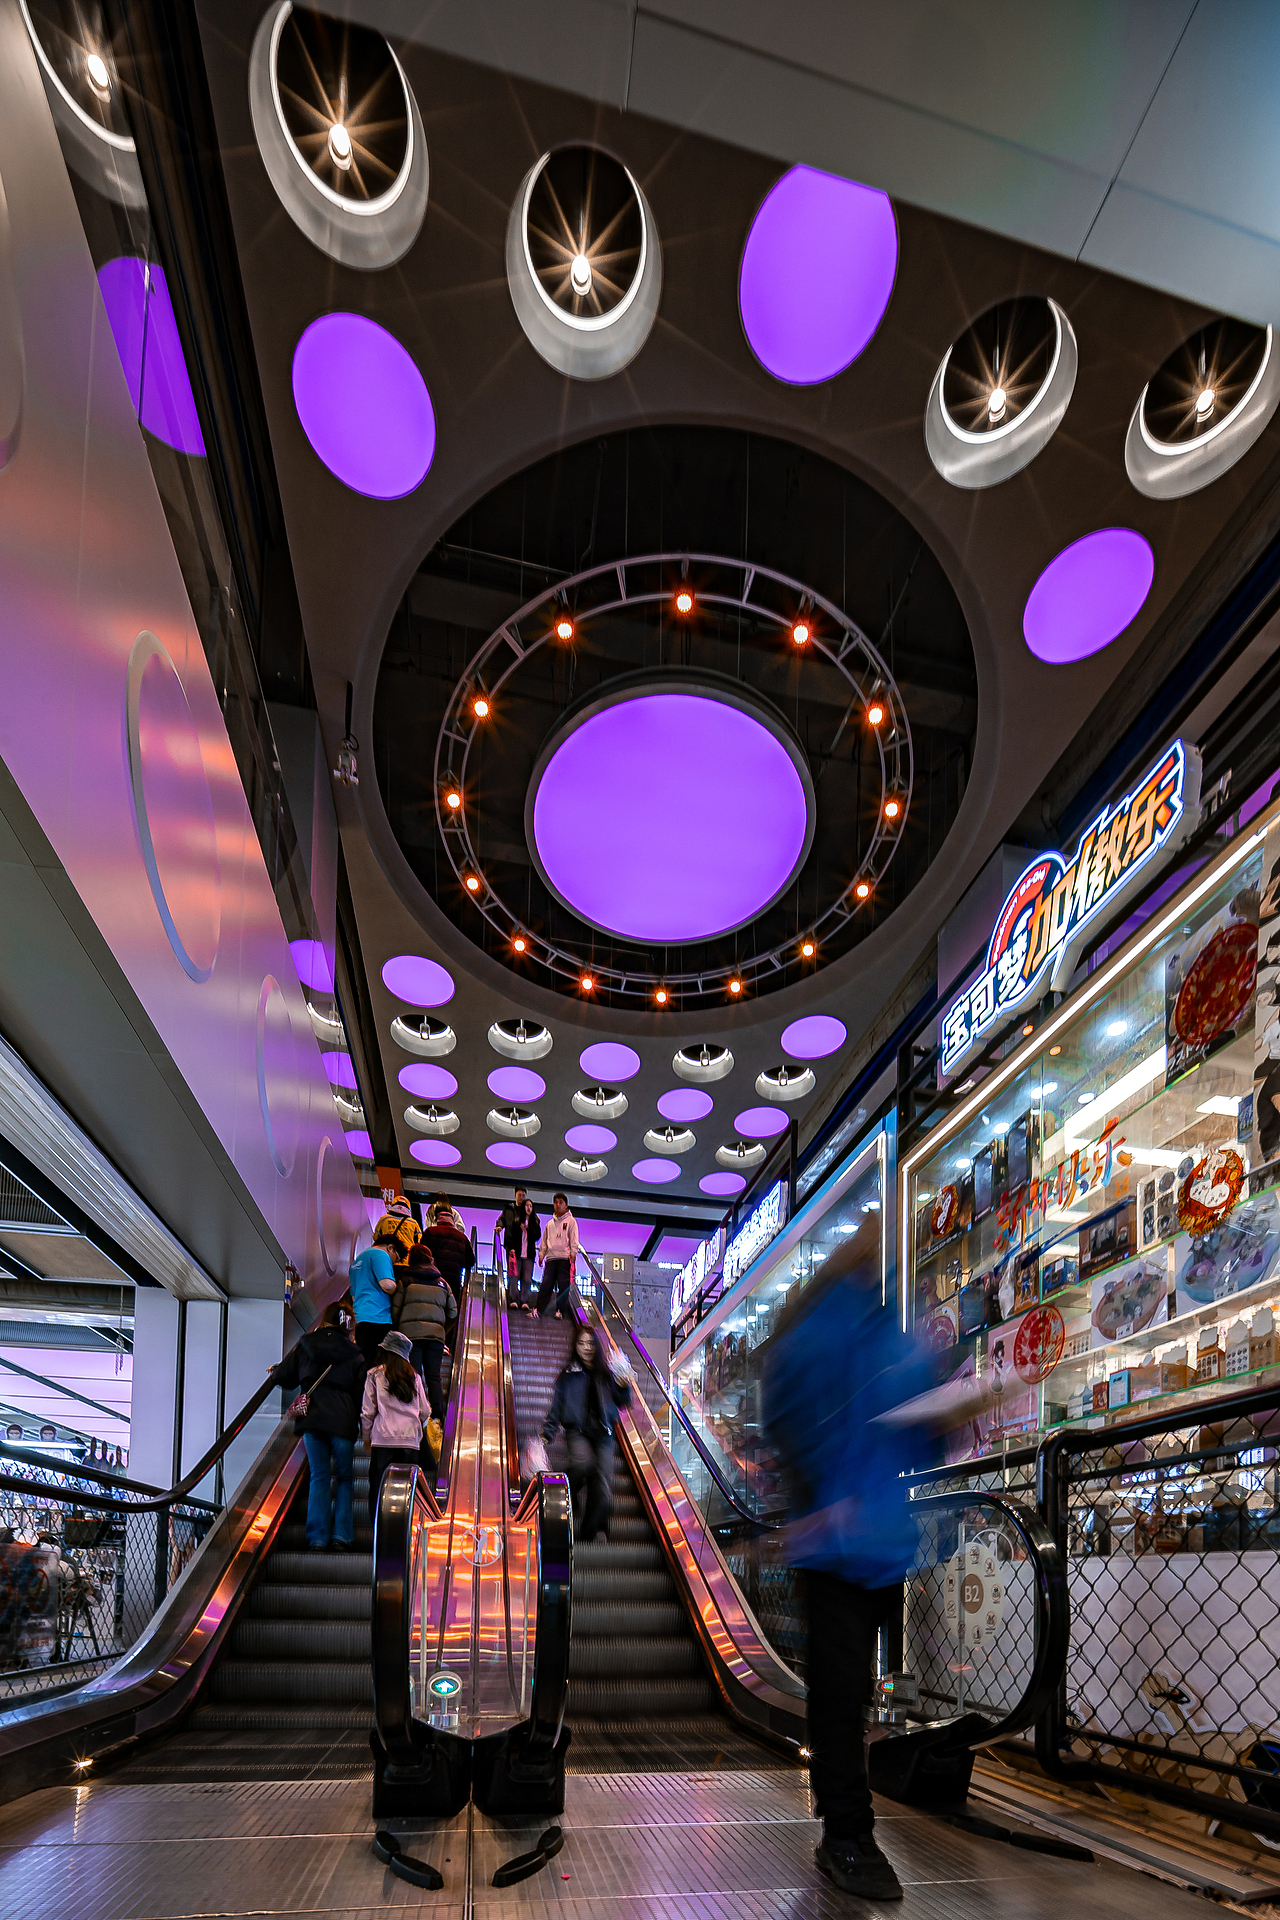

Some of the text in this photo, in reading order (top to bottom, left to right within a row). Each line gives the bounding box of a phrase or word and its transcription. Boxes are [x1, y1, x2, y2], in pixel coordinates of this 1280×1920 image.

[992, 1115, 1134, 1253] 新年快乐
[612, 1257, 626, 1272] B1
[964, 1585, 980, 1603] B2
